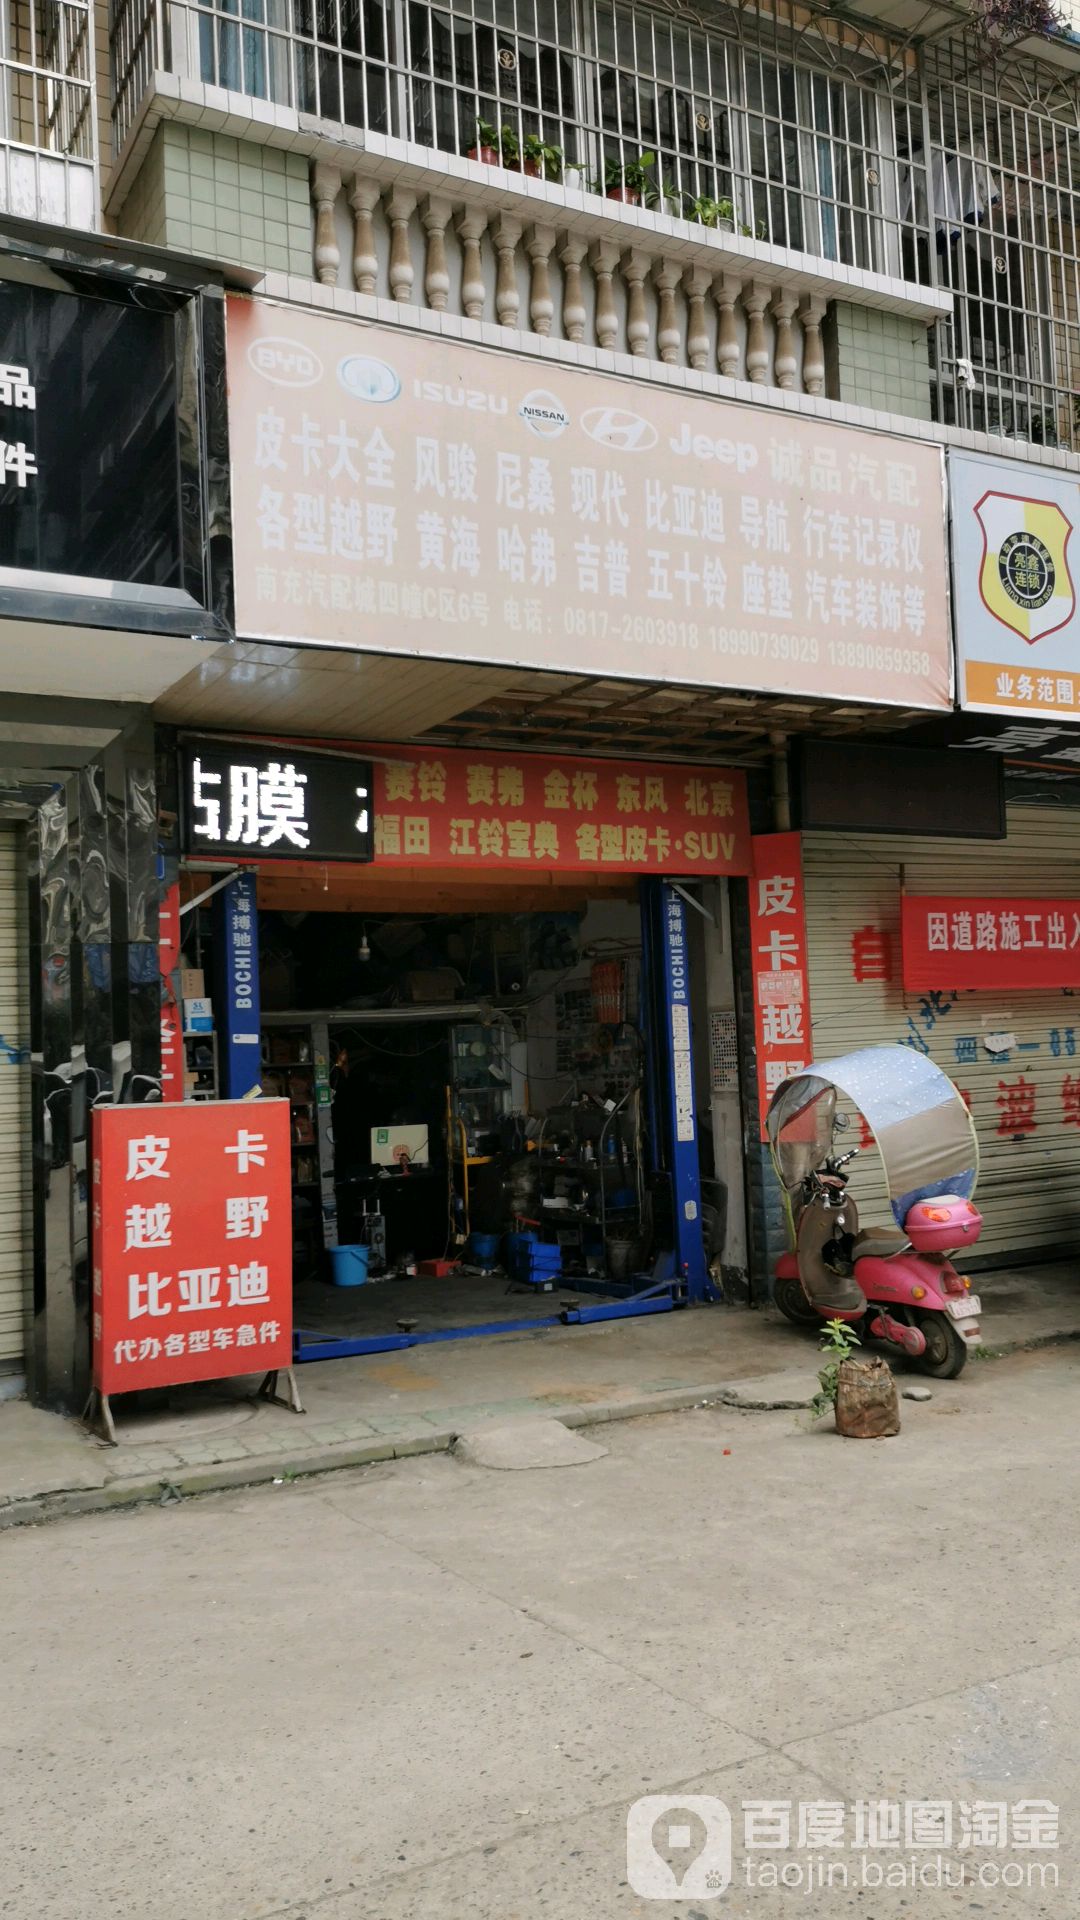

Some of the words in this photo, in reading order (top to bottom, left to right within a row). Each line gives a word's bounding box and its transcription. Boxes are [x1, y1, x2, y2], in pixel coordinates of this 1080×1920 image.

[0, 364, 36, 410] 品
[257, 348, 315, 377] BYD
[413, 380, 508, 414] ISUZU
[523, 406, 566, 422] NISSAN
[0, 440, 38, 487] 件
[669, 423, 758, 472] Jeep
[255, 406, 395, 488] 皮卡大全
[414, 435, 478, 504] 风骏
[496, 452, 555, 515] 尼桑
[570, 466, 629, 528] 现代
[645, 478, 726, 543] 比亚迪
[739, 495, 790, 552] 导航
[803, 505, 924, 573] 行车记录仪
[767, 437, 919, 508] 诚品汽配
[257, 484, 398, 566] 各型越野
[416, 510, 481, 578] 黄海
[497, 524, 557, 587] 哈弗
[575, 534, 630, 599] 吉普
[647, 548, 727, 611] 五十铃
[742, 561, 793, 619] 座垫
[805, 569, 926, 637] 汽车装饰等
[543, 768, 599, 811] 金杯
[615, 774, 668, 813] 东风
[684, 778, 735, 818] 北京
[373, 814, 431, 857] 福田
[449, 818, 560, 860] 江铃宝典
[234, 949, 253, 1009] BOCHI
[671, 949, 687, 1000] BOCHI
[128, 1261, 271, 1321] 比亚迪
[113, 1320, 282, 1366] 代办各型车急件
